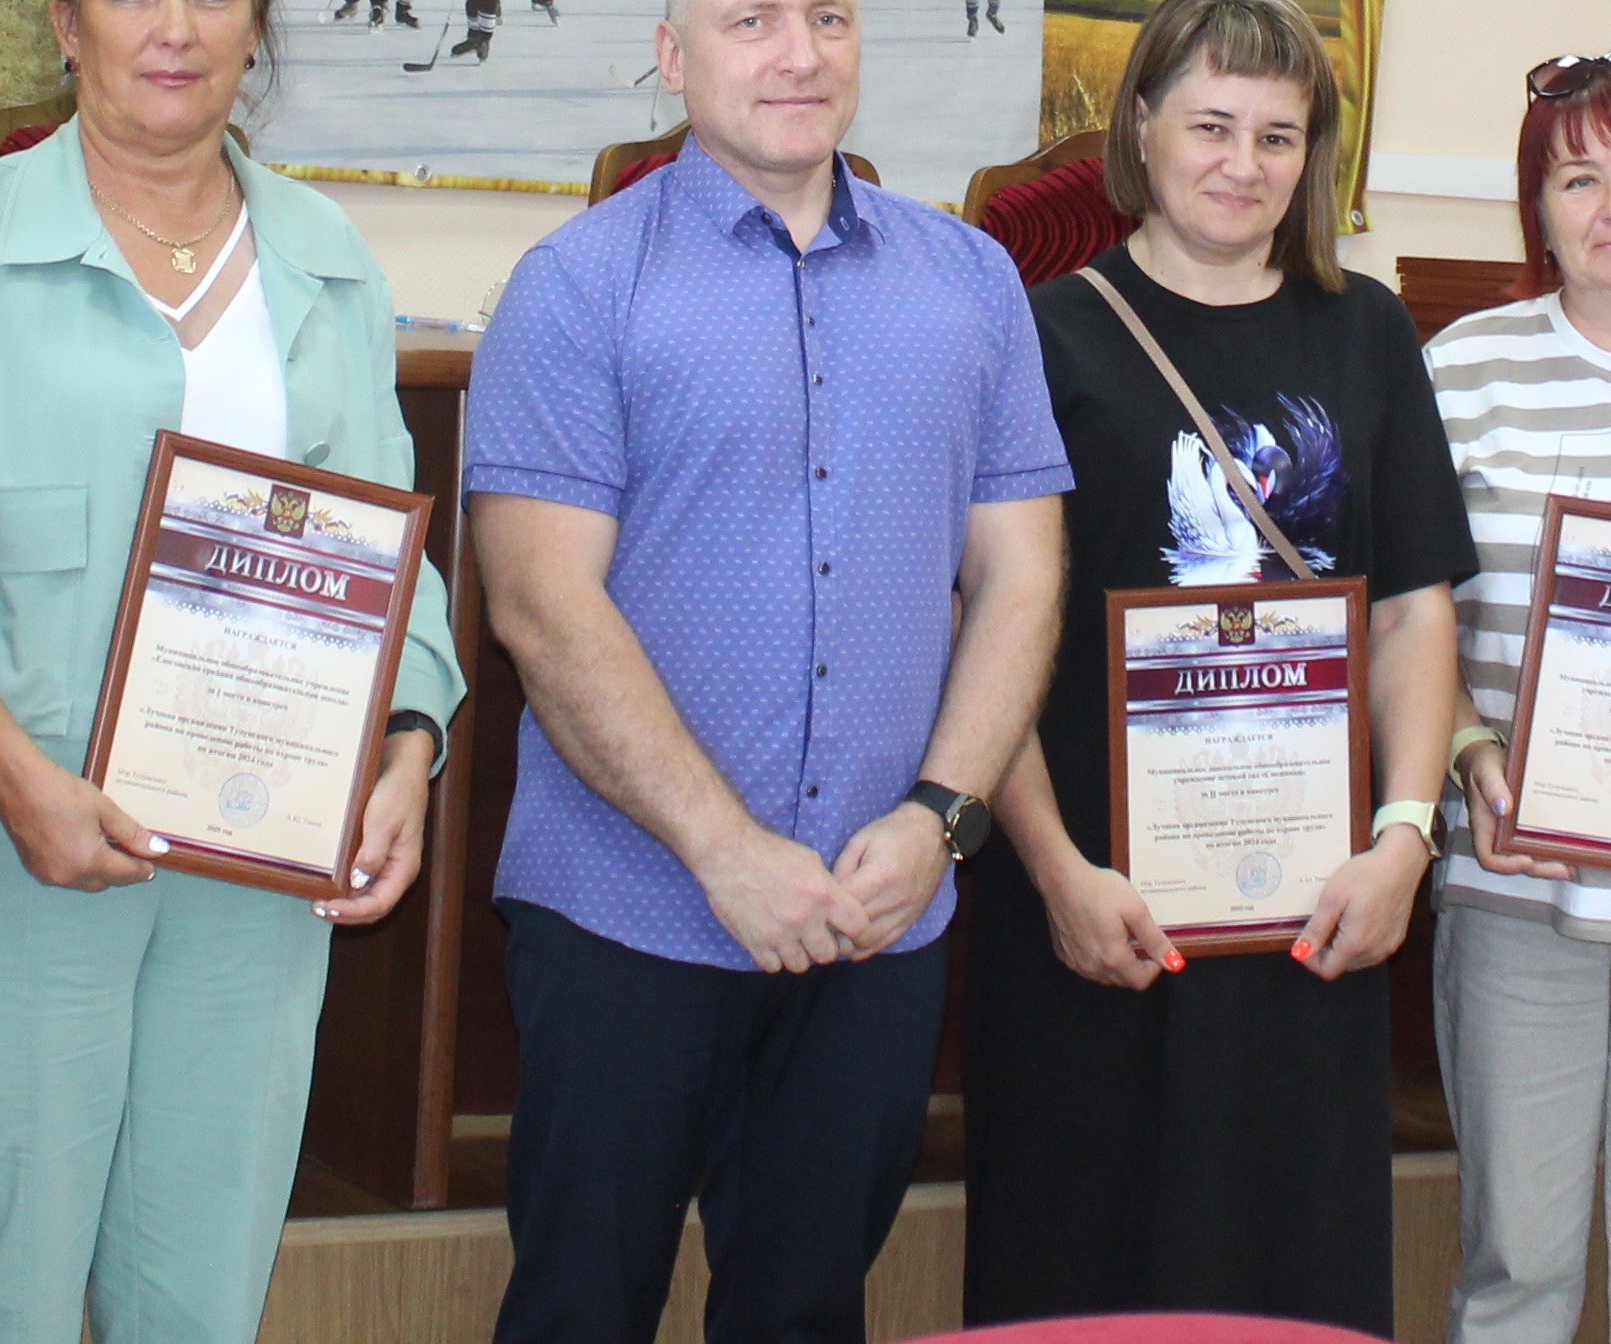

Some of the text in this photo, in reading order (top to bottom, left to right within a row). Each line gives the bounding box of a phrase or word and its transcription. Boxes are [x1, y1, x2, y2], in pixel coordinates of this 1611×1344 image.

[205, 544, 350, 601] ДИПЛОМ
[222, 625, 298, 651] НАГРАЖДАЕТСЯ
[1174, 662, 1307, 695] ДИПЛОМ
